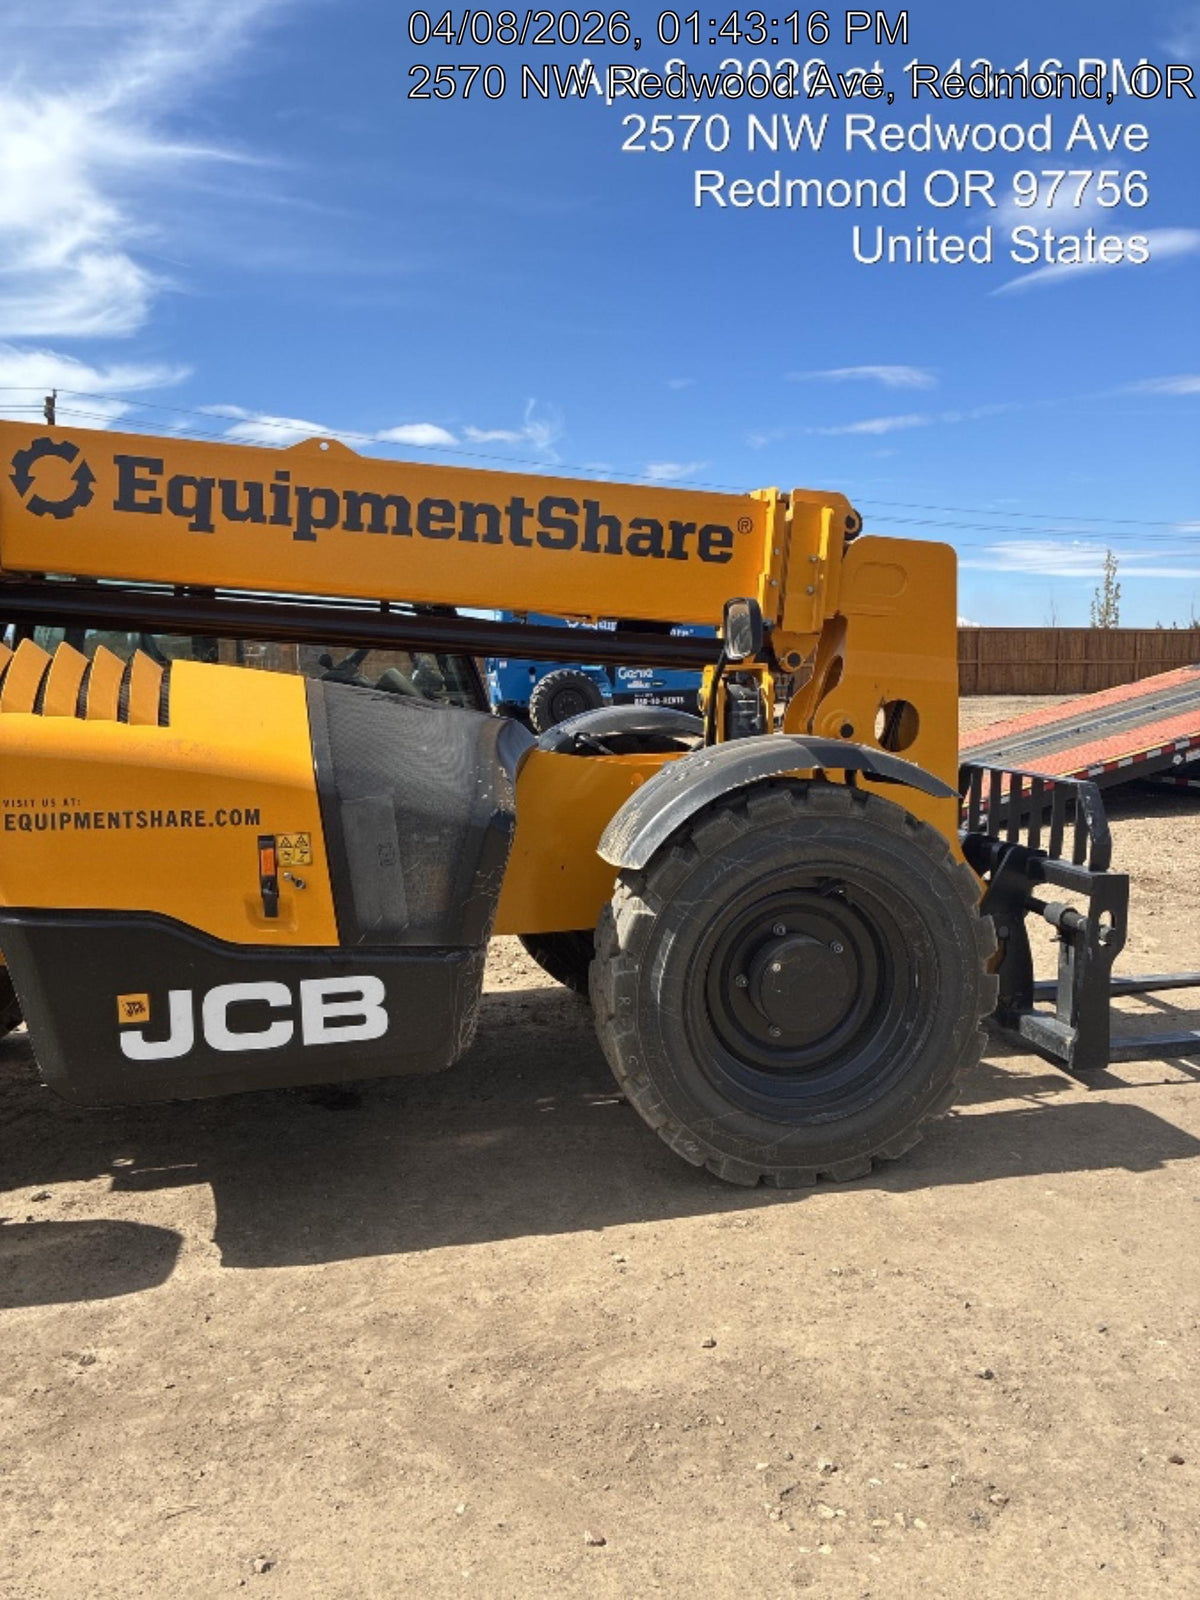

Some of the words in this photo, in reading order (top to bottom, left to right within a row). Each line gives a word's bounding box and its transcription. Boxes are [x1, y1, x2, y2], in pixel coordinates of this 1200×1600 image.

[3, 799, 35, 808] VISIT
[42, 798, 56, 807] US
[4, 808, 261, 832] EQUIPMENTSHARE.COM
[119, 975, 389, 1061] JCB
